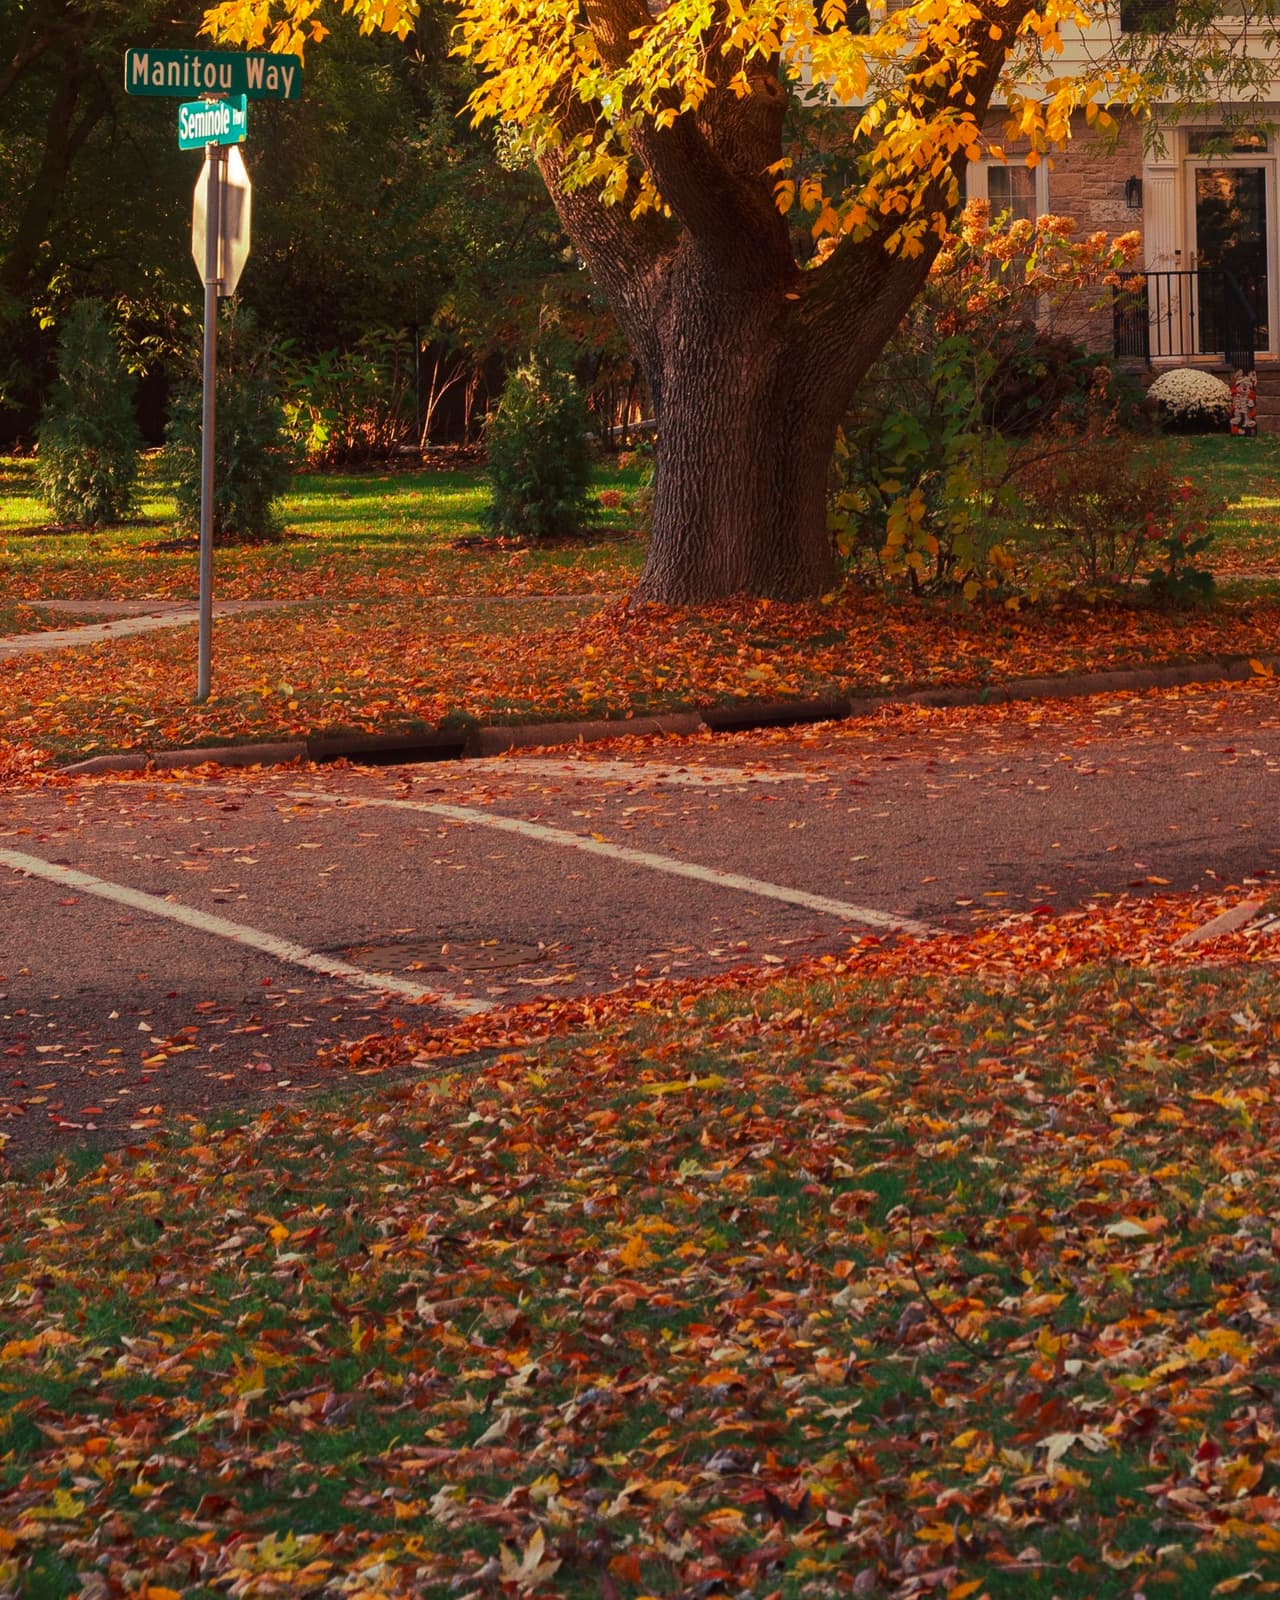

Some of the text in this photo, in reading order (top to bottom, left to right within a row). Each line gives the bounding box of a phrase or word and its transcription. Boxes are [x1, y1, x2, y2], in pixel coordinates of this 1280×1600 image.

[132, 53, 295, 99] Manitou Way
[180, 103, 245, 140] Seminole Hwy
